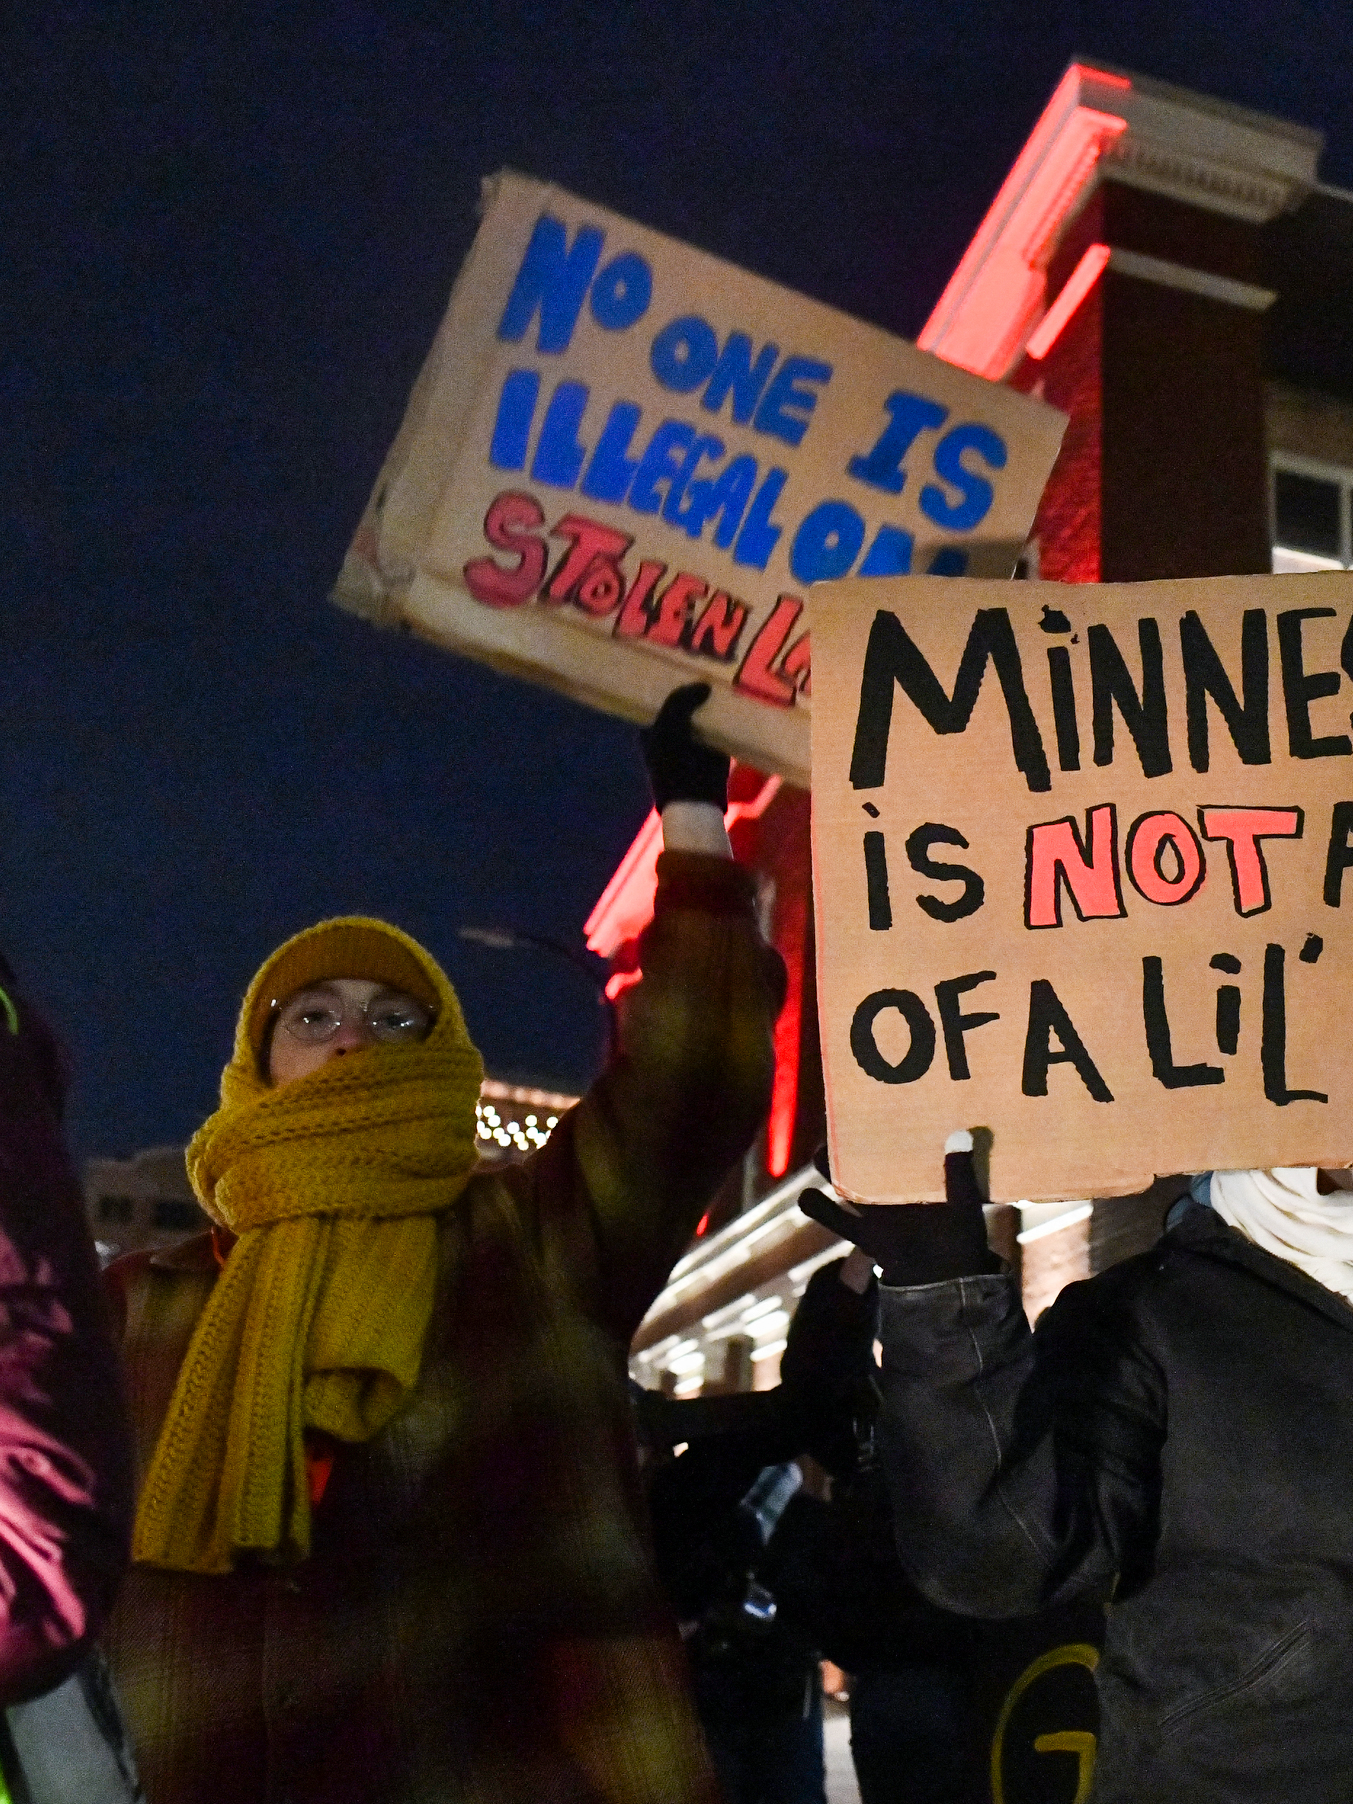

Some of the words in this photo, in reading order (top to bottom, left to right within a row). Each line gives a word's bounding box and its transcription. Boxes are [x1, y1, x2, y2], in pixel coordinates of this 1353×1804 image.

[499, 214, 653, 355] NO
[650, 316, 833, 447] ONE
[847, 390, 1008, 532] IS
[489, 369, 788, 573] ILLEGAL
[463, 490, 751, 664] STOLEN
[1024, 802, 1304, 929] NOT
[849, 970, 1001, 1085] OF
[1020, 979, 1115, 1104] A
